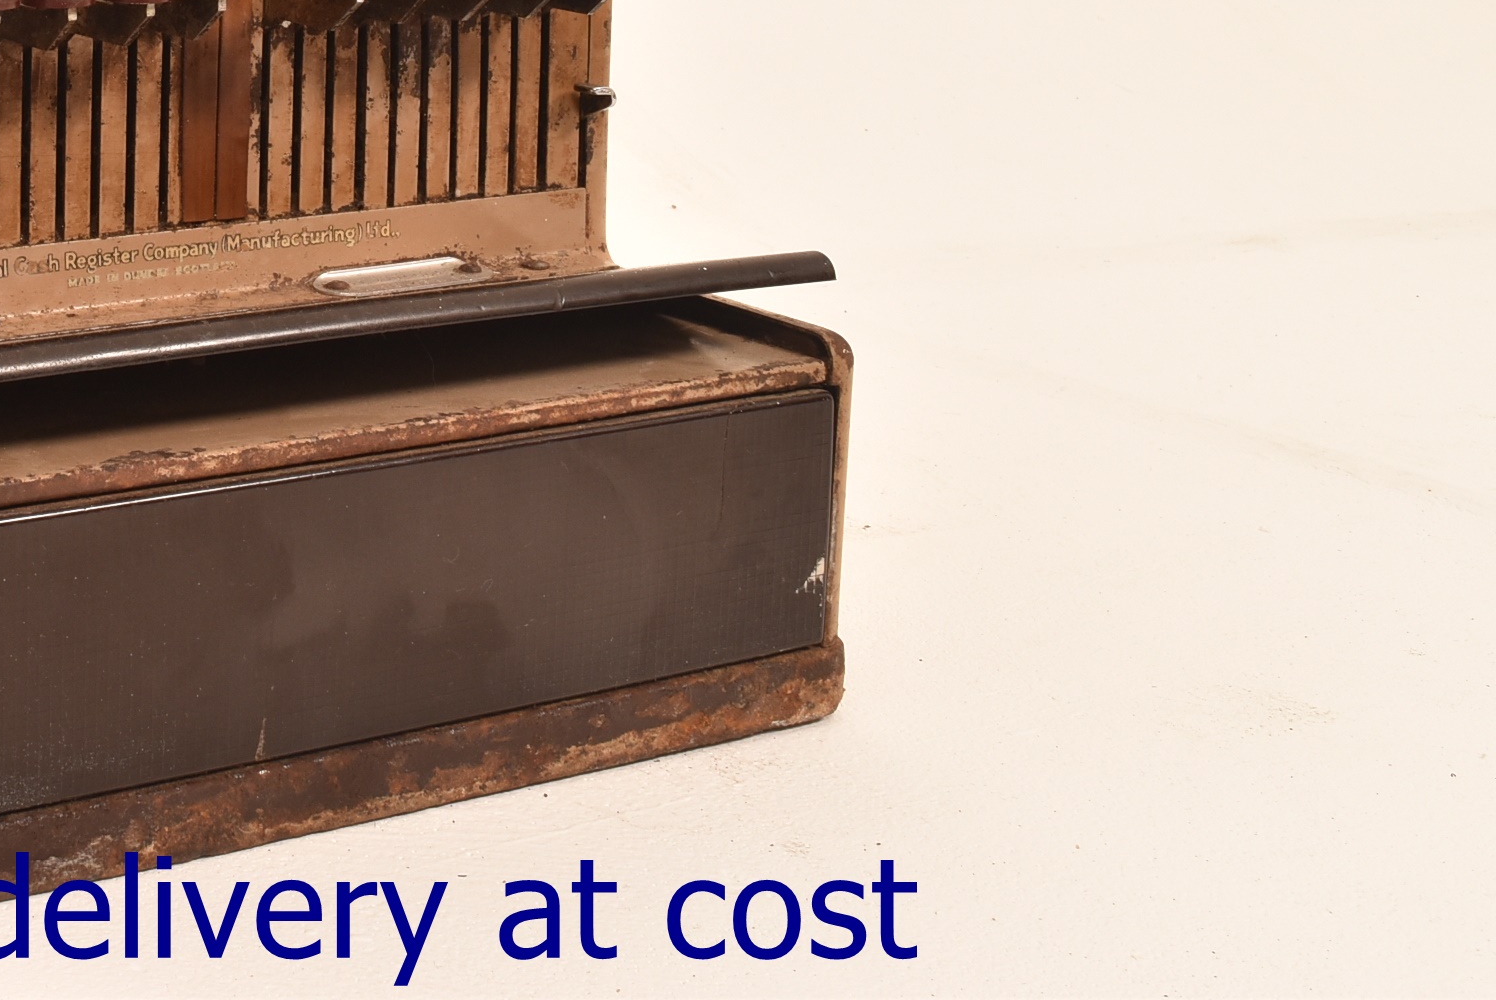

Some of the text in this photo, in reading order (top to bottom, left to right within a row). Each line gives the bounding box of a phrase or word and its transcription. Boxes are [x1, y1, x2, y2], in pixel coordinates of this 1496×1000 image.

[14, 254, 60, 276] Cash
[64, 247, 140, 274] Register
[143, 240, 218, 263] Company
[221, 223, 363, 254] (Manufacturing)
[68, 274, 101, 288] MADE
